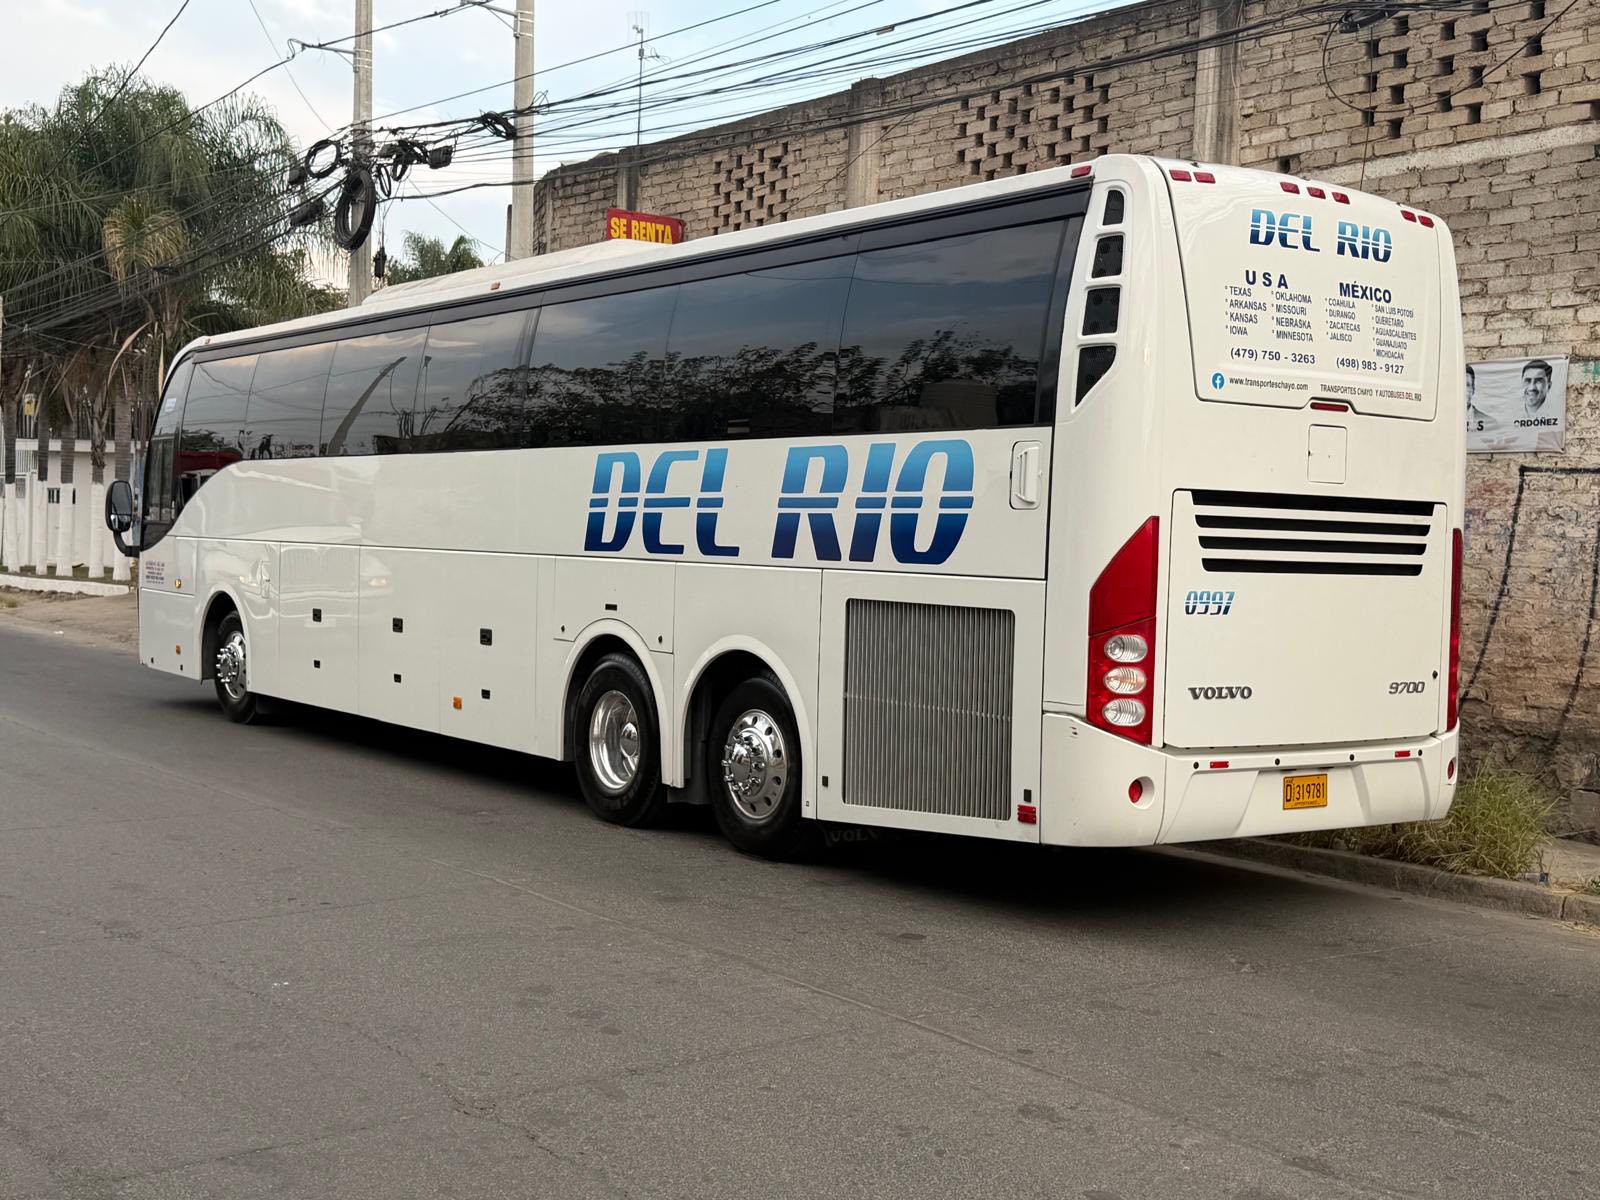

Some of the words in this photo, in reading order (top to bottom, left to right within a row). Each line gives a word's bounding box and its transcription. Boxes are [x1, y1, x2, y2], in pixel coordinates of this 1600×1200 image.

[610, 217, 627, 240] SE
[631, 219, 673, 245] RENTA
[1249, 208, 1321, 252] DEL
[1336, 220, 1393, 263] RIO
[1229, 285, 1252, 297] TEXAS
[1275, 291, 1312, 304] OKLAHOMA
[1338, 280, 1392, 304] MÉXICO
[1229, 298, 1267, 312] ARKANSAS
[1275, 303, 1307, 316] MISSOURI
[1328, 297, 1356, 309] COAHUILA
[1374, 304, 1385, 313] SAN
[1385, 305, 1397, 315] LUIS
[1229, 312, 1258, 324] KANSAS
[1328, 308, 1356, 320] DURANGO
[1275, 316, 1312, 330] NEBRASKA
[1329, 320, 1361, 332] ZACATECAS
[1229, 325, 1249, 336] IOWA
[1276, 329, 1314, 342] MINNESOTA
[1329, 332, 1353, 343] JALISCO
[1375, 327, 1417, 341] AGUASCALIENTES
[1375, 337, 1408, 350] GUANAJUATO
[1230, 347, 1258, 361] (479)
[1261, 350, 1281, 361] 750
[1291, 352, 1316, 364] 3263
[1336, 357, 1360, 370] (498)
[1361, 360, 1377, 371] 983
[1385, 363, 1404, 374] 9127
[1229, 376, 1309, 392] www.transporteschayo.com
[1320, 383, 1357, 396] TRANSPORTES
[1379, 389, 1404, 400] AUTOBUSES
[583, 447, 741, 558] DEL
[770, 438, 975, 565] RIO
[1184, 590, 1236, 616] 0997
[1187, 685, 1253, 701] VOLVO
[1388, 681, 1426, 695] 9700
